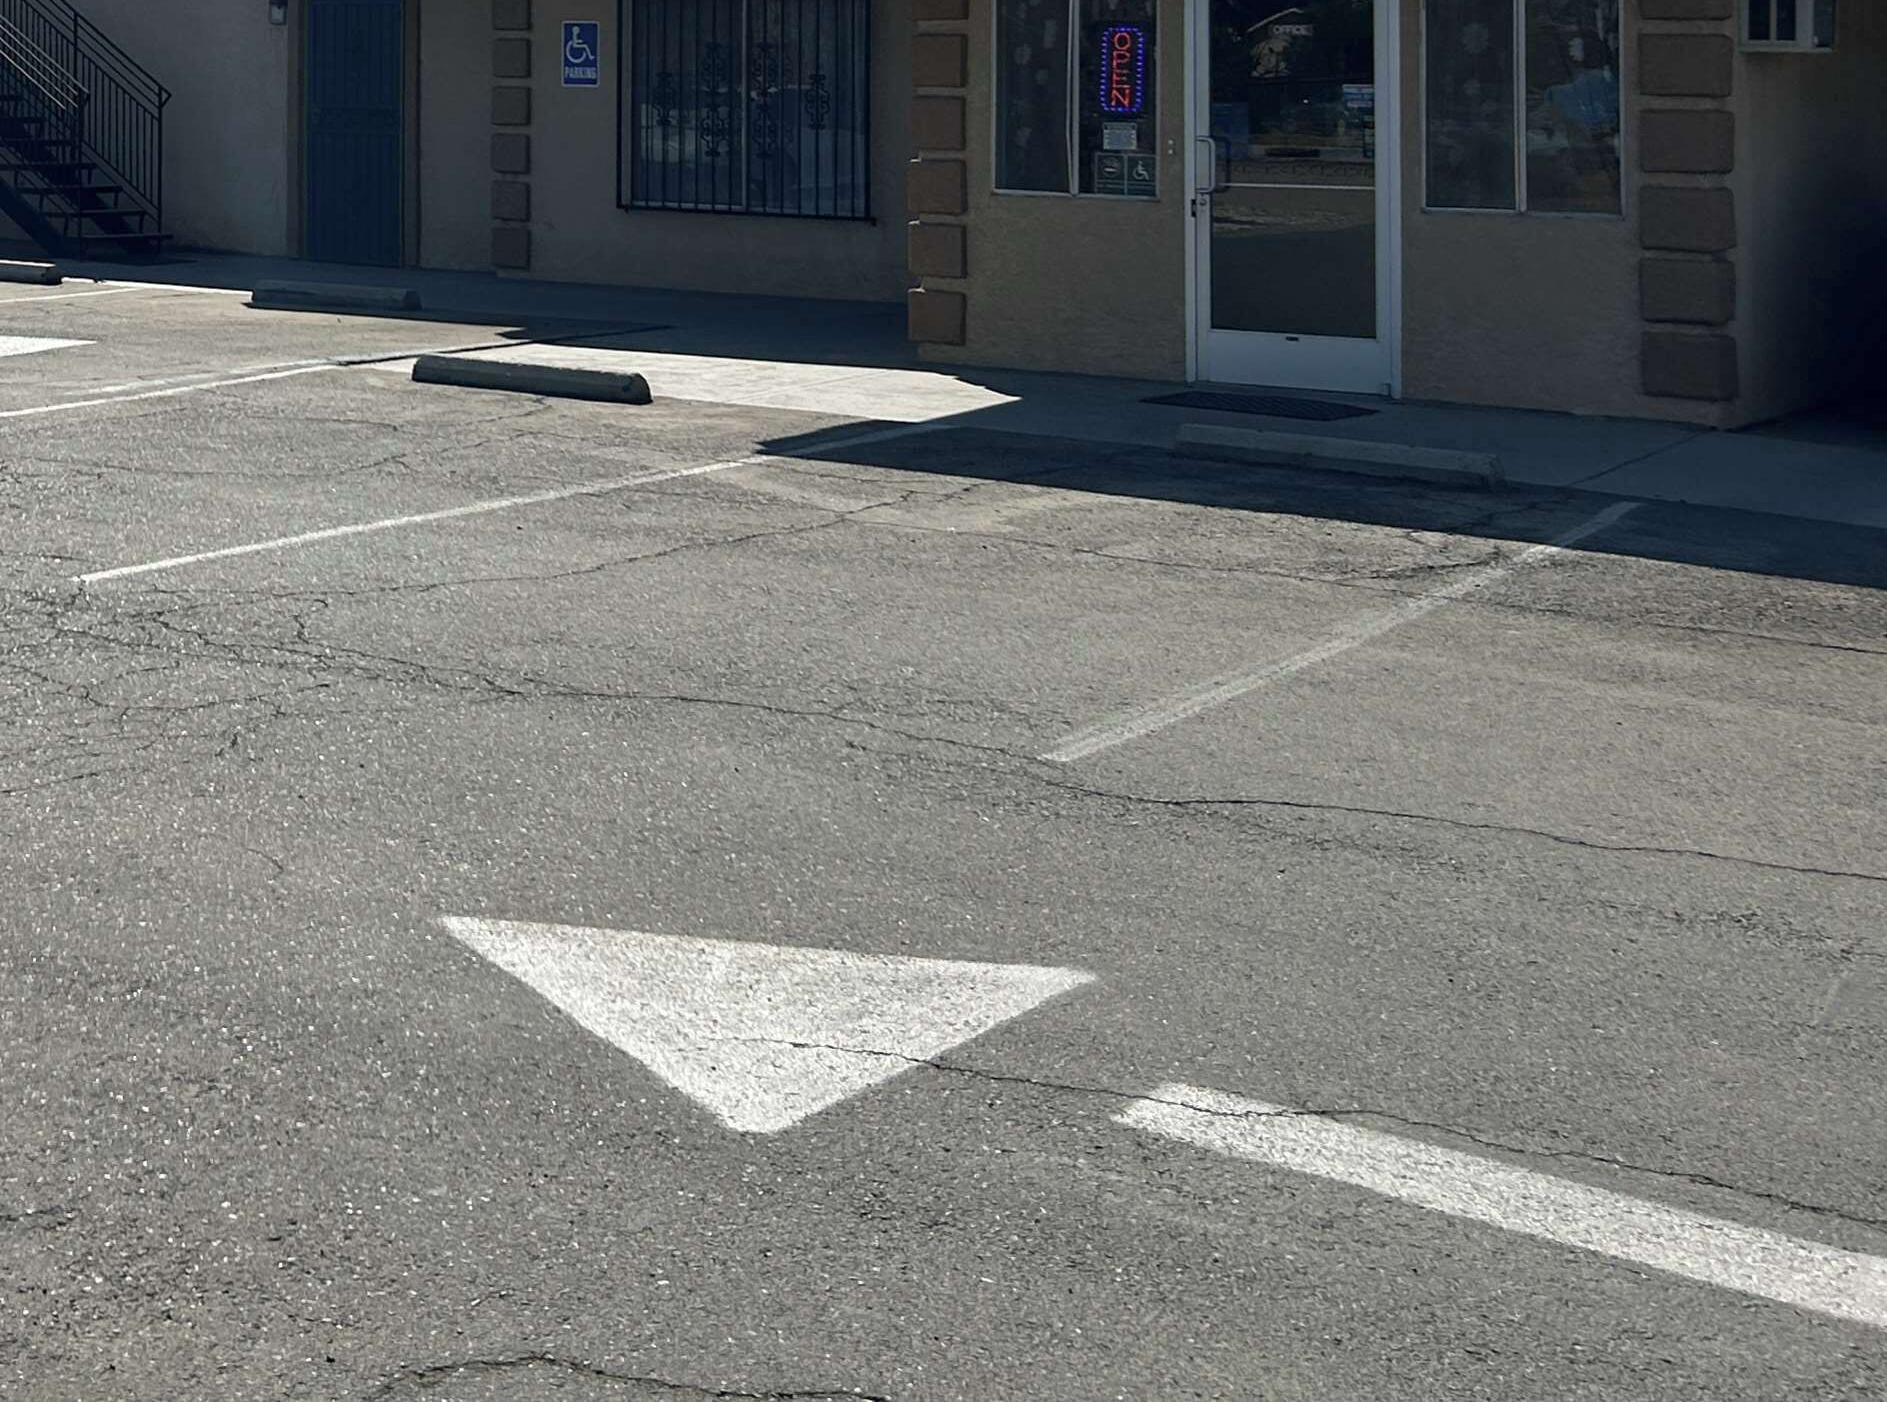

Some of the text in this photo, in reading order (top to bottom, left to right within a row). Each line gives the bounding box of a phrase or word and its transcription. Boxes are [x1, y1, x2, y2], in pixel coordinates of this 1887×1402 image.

[1272, 24, 1309, 36] OFFICE
[565, 66, 597, 79] PARKING
[1110, 31, 1132, 108] OPEN
